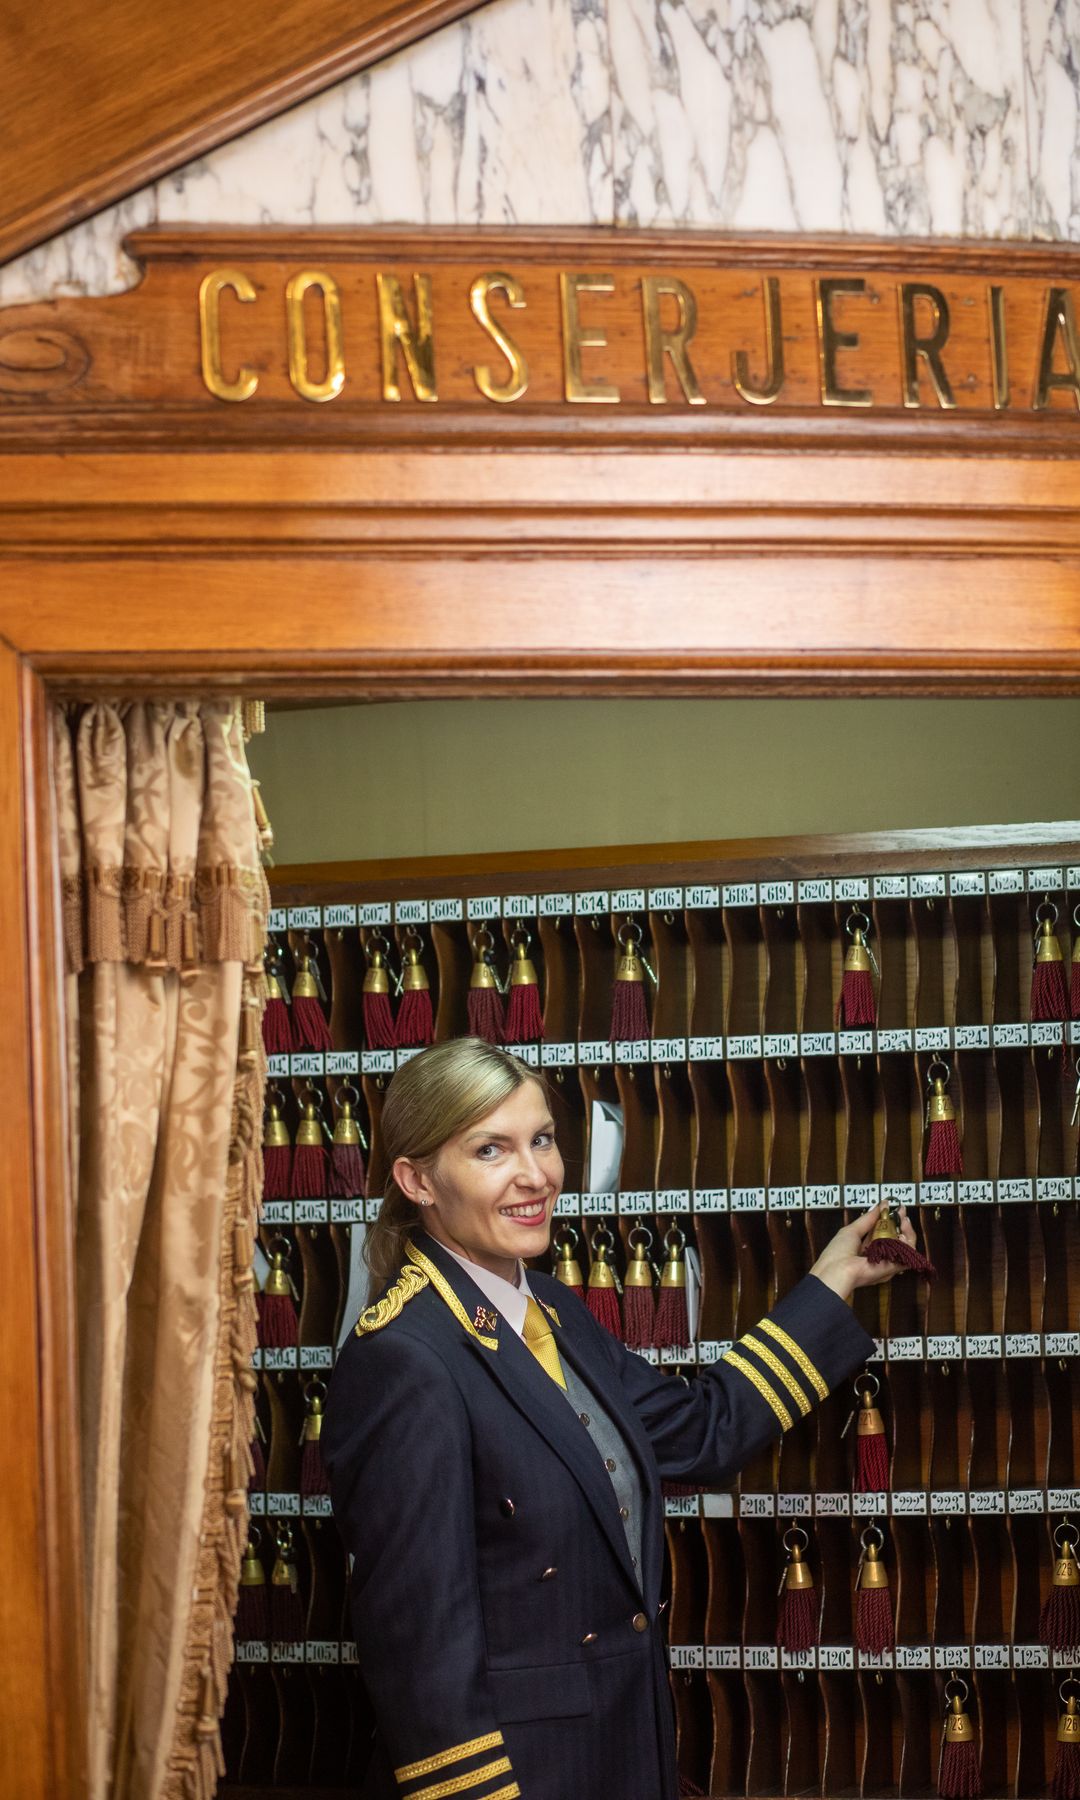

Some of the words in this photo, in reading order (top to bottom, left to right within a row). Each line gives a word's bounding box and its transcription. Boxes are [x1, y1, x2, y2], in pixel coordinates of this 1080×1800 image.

[199, 270, 1080, 412] CONSERJERIA
[767, 885, 786, 900] 619
[804, 883, 826, 898] 620
[841, 882, 860, 897] 621
[880, 880, 900, 895] 622
[916, 879, 939, 894] 623
[956, 878, 978, 892] 624
[581, 895, 605, 911] 614
[618, 893, 637, 908] 615
[654, 891, 675, 907] 616
[692, 889, 711, 905] 617
[728, 887, 748, 903] 618
[400, 903, 420, 919] 608
[434, 902, 457, 916] 609
[473, 900, 493, 915] 610
[511, 899, 528, 913] 611
[545, 897, 564, 912] 612
[293, 909, 315, 924] 605
[328, 908, 350, 923] 606
[363, 906, 384, 921] 607
[921, 1032, 943, 1047] 523
[961, 1030, 983, 1045] 524
[1000, 1027, 1022, 1043] 525
[1038, 1025, 1060, 1042] 526
[658, 1043, 678, 1058] 516
[696, 1041, 715, 1057] 517
[734, 1040, 754, 1055] 518
[770, 1038, 790, 1054] 519
[807, 1036, 830, 1052] 520
[846, 1035, 866, 1050] 521
[548, 1047, 566, 1062] 512
[585, 1045, 604, 1060] 514
[623, 1044, 642, 1060] 515
[331, 1055, 352, 1070] 506
[367, 1054, 387, 1069] 507
[812, 1189, 834, 1205] 420
[851, 1188, 870, 1204] 421
[925, 1185, 948, 1200] 423
[964, 1185, 987, 1200] 424
[1004, 1183, 1026, 1199] 425
[1042, 1181, 1065, 1197] 426
[589, 1196, 608, 1211] 414
[626, 1195, 646, 1210] 415
[662, 1194, 682, 1209] 416
[700, 1193, 719, 1208] 417
[737, 1192, 757, 1207] 418
[776, 1190, 795, 1206] 419
[300, 1204, 322, 1219] 405
[335, 1204, 358, 1219] 406
[893, 1341, 916, 1357] 322
[933, 1340, 955, 1356] 323
[973, 1339, 995, 1355] 324
[1012, 1338, 1034, 1354] 325
[1052, 1337, 1074, 1353] 326
[305, 1350, 326, 1365] 305
[672, 1497, 691, 1513] 216
[746, 1498, 766, 1514] 218
[785, 1498, 805, 1514] 219
[822, 1497, 843, 1512] 220
[860, 1496, 879, 1512] 221
[899, 1495, 920, 1512] 222
[937, 1495, 959, 1511] 223
[976, 1495, 998, 1511] 224
[1015, 1494, 1038, 1510] 225
[1055, 1492, 1078, 1509] 226
[678, 1650, 696, 1665] 116
[715, 1650, 732, 1666] 117
[752, 1650, 770, 1666] 118
[790, 1650, 807, 1666] 119
[827, 1651, 846, 1666] 120
[903, 1650, 923, 1666] 122
[943, 1649, 963, 1665] 123
[982, 1649, 1002, 1665] 124
[1021, 1649, 1041, 1665] 125
[1060, 1649, 1080, 1665] 126
